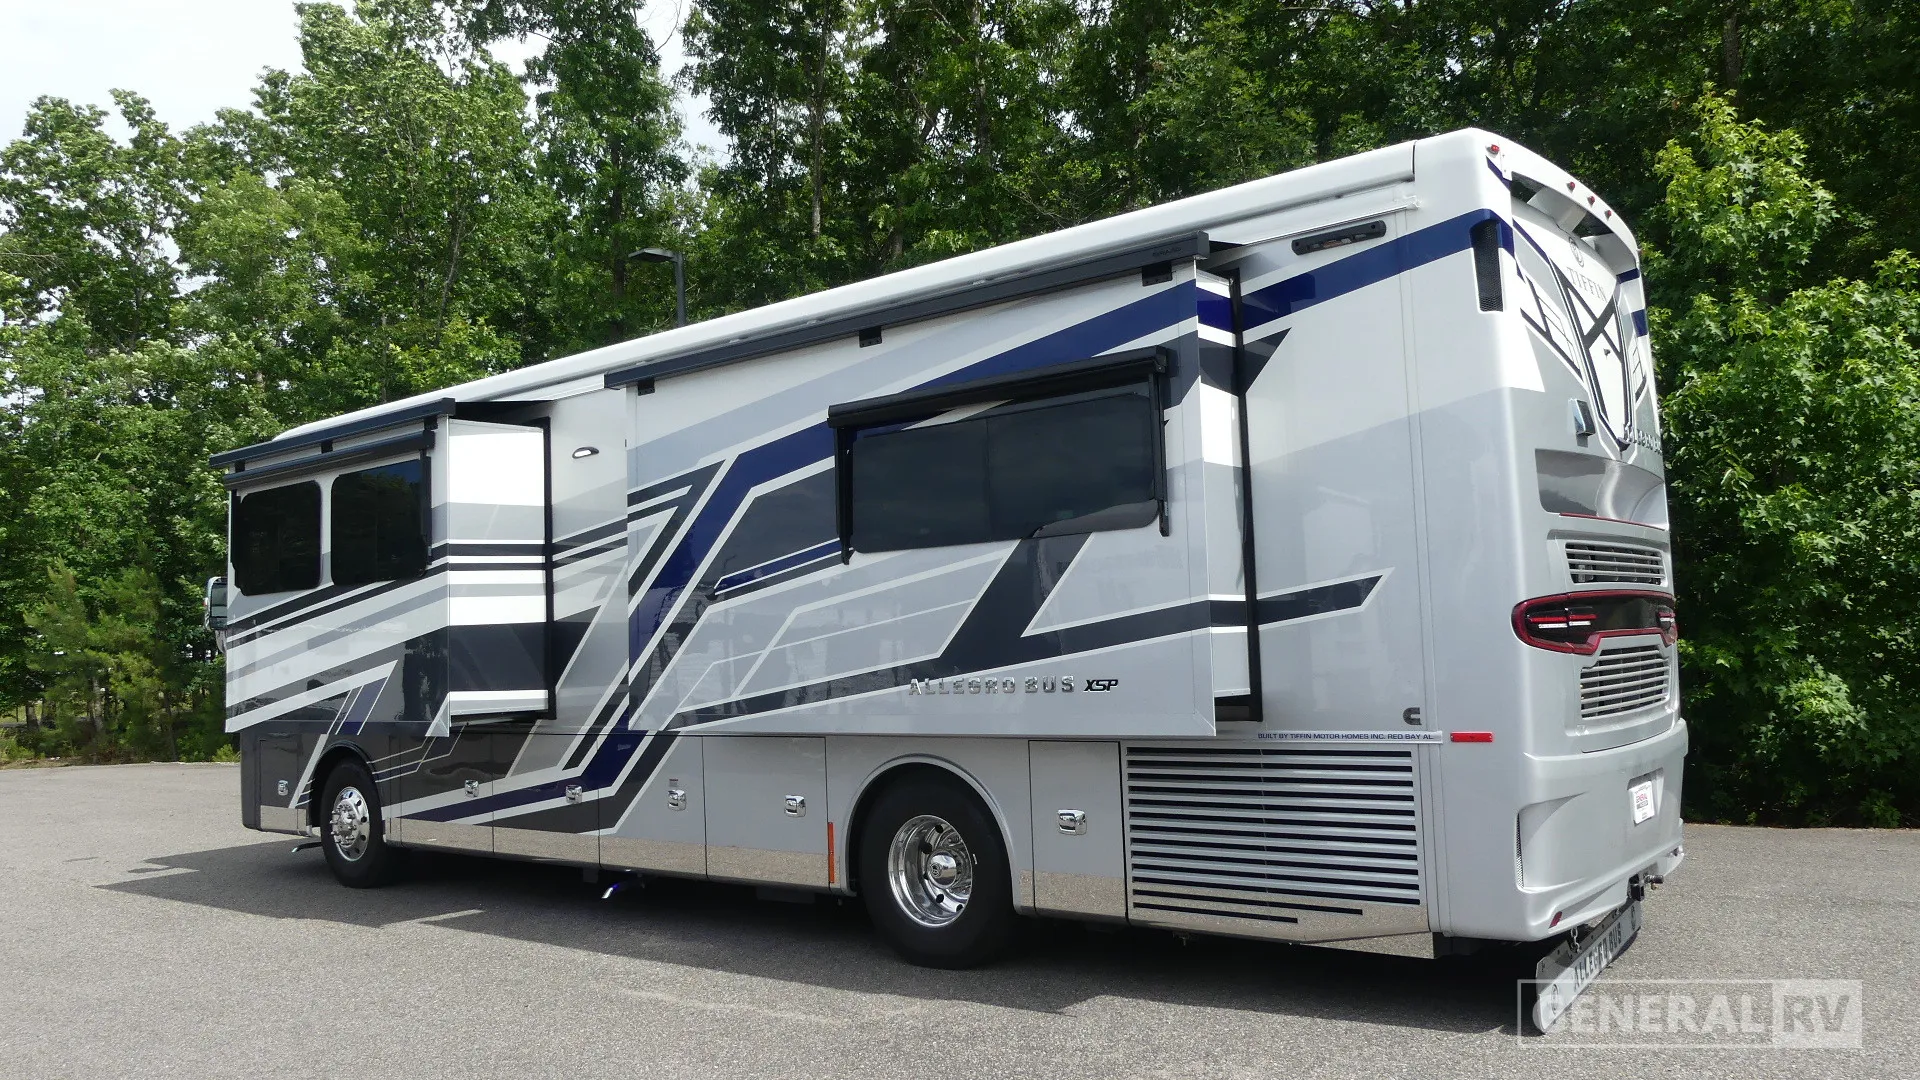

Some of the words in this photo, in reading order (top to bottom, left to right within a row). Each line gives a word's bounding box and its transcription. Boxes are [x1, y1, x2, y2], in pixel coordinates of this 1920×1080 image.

[1566, 266, 1608, 303] TIFFIN
[908, 677, 1016, 696] ALLEGRO
[1024, 675, 1075, 693] BUS
[1083, 679, 1119, 693] XSP
